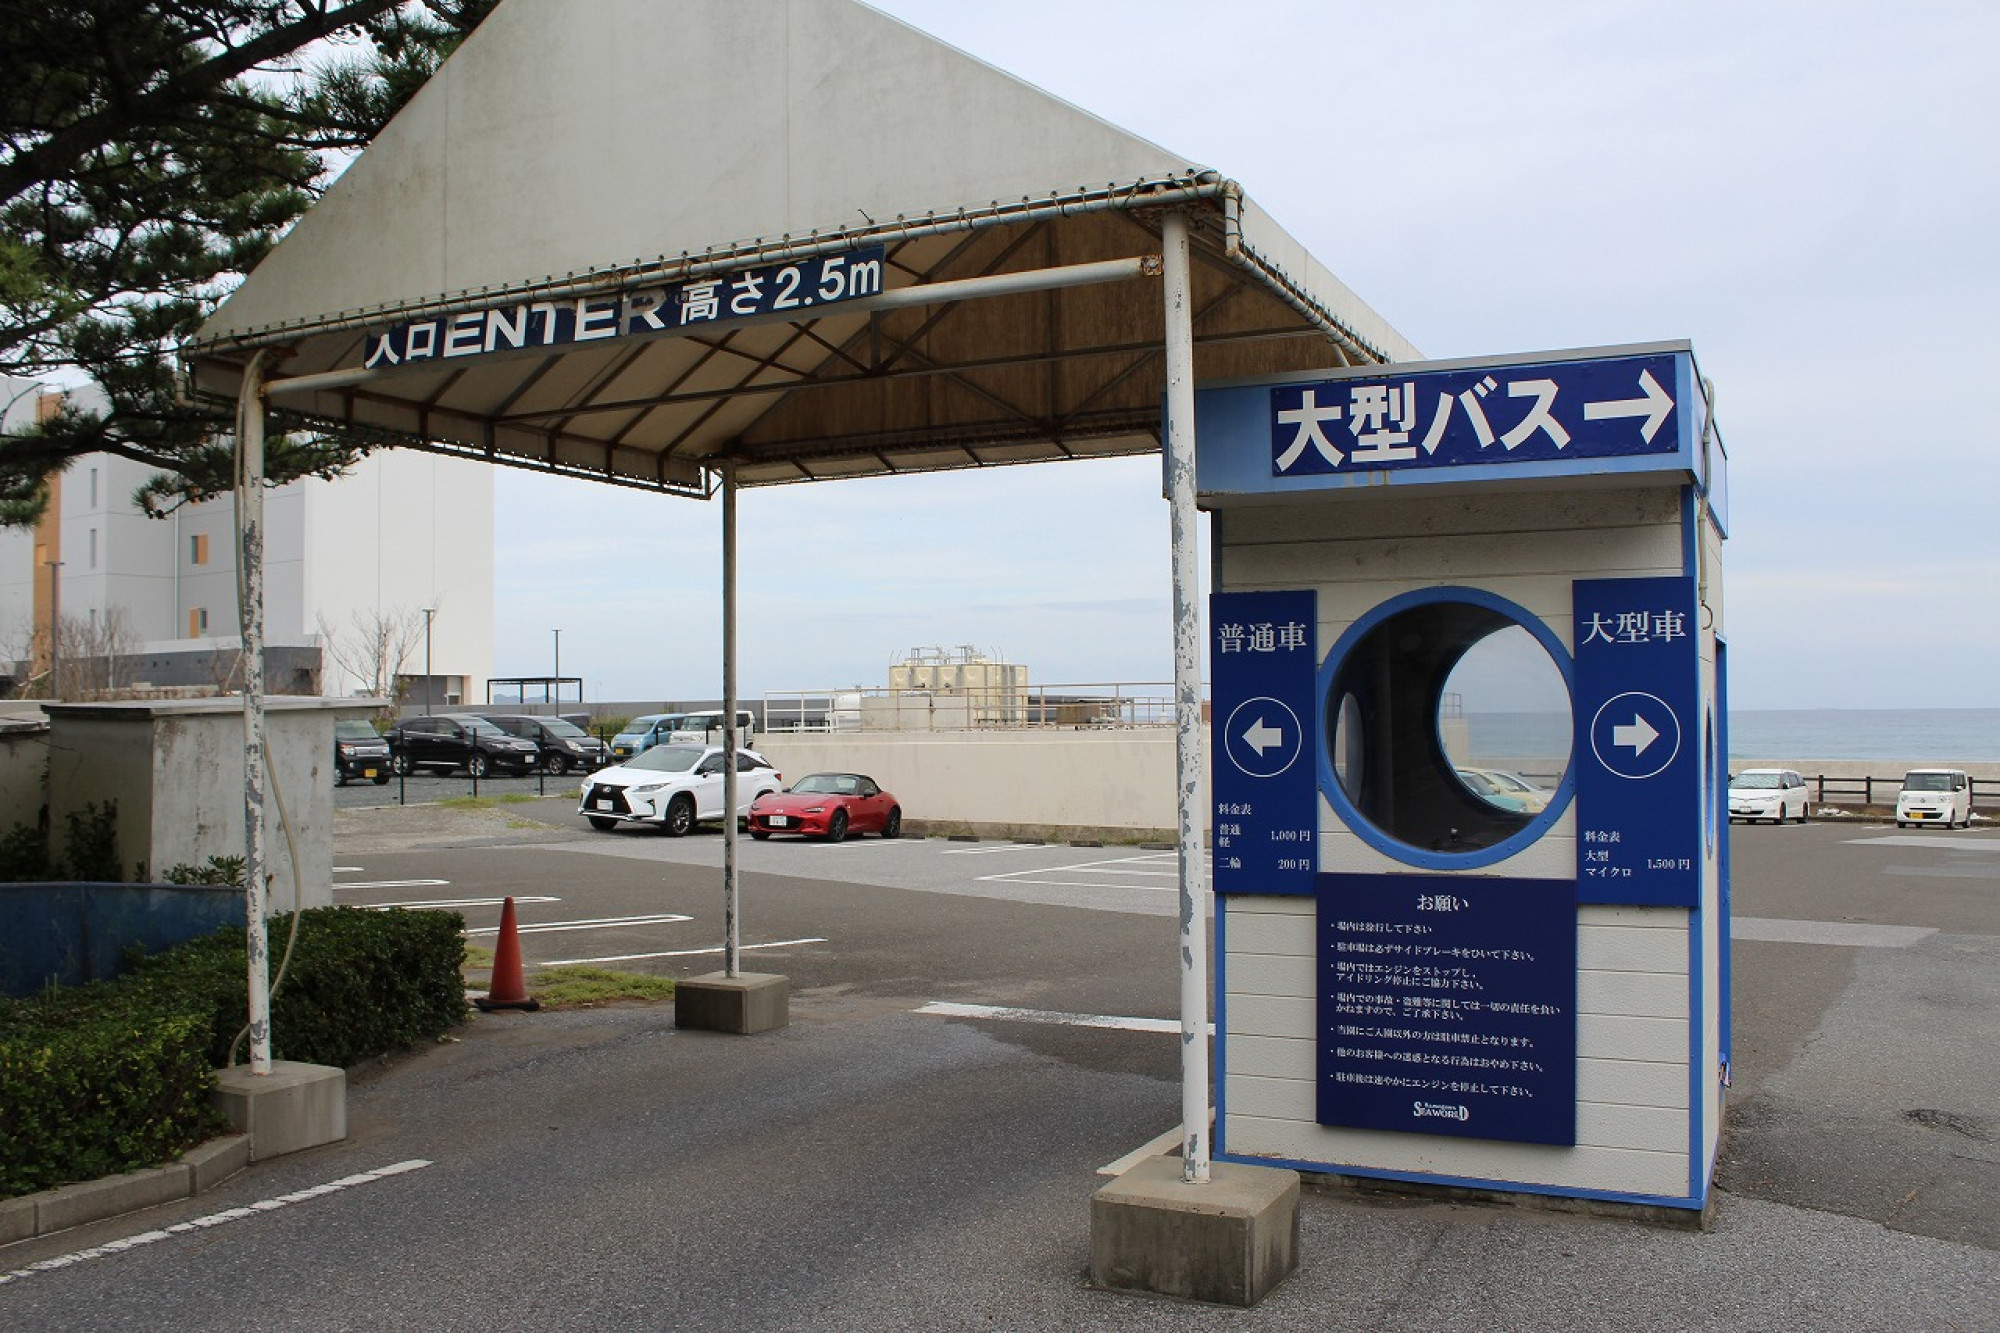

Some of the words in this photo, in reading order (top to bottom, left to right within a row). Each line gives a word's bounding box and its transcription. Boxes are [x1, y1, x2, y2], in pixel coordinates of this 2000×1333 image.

[1276, 375, 1571, 471] 大型バス
[1582, 610, 1686, 644] 大型車
[1217, 622, 1307, 653] 普通車
[1219, 803, 1251, 814] 料金表
[1219, 823, 1242, 836] 普通
[1586, 831, 1620, 842] 料金表
[1586, 850, 1608, 861] 大型
[1585, 866, 1632, 878] マイクロ
[1417, 894, 1469, 911] お願い
